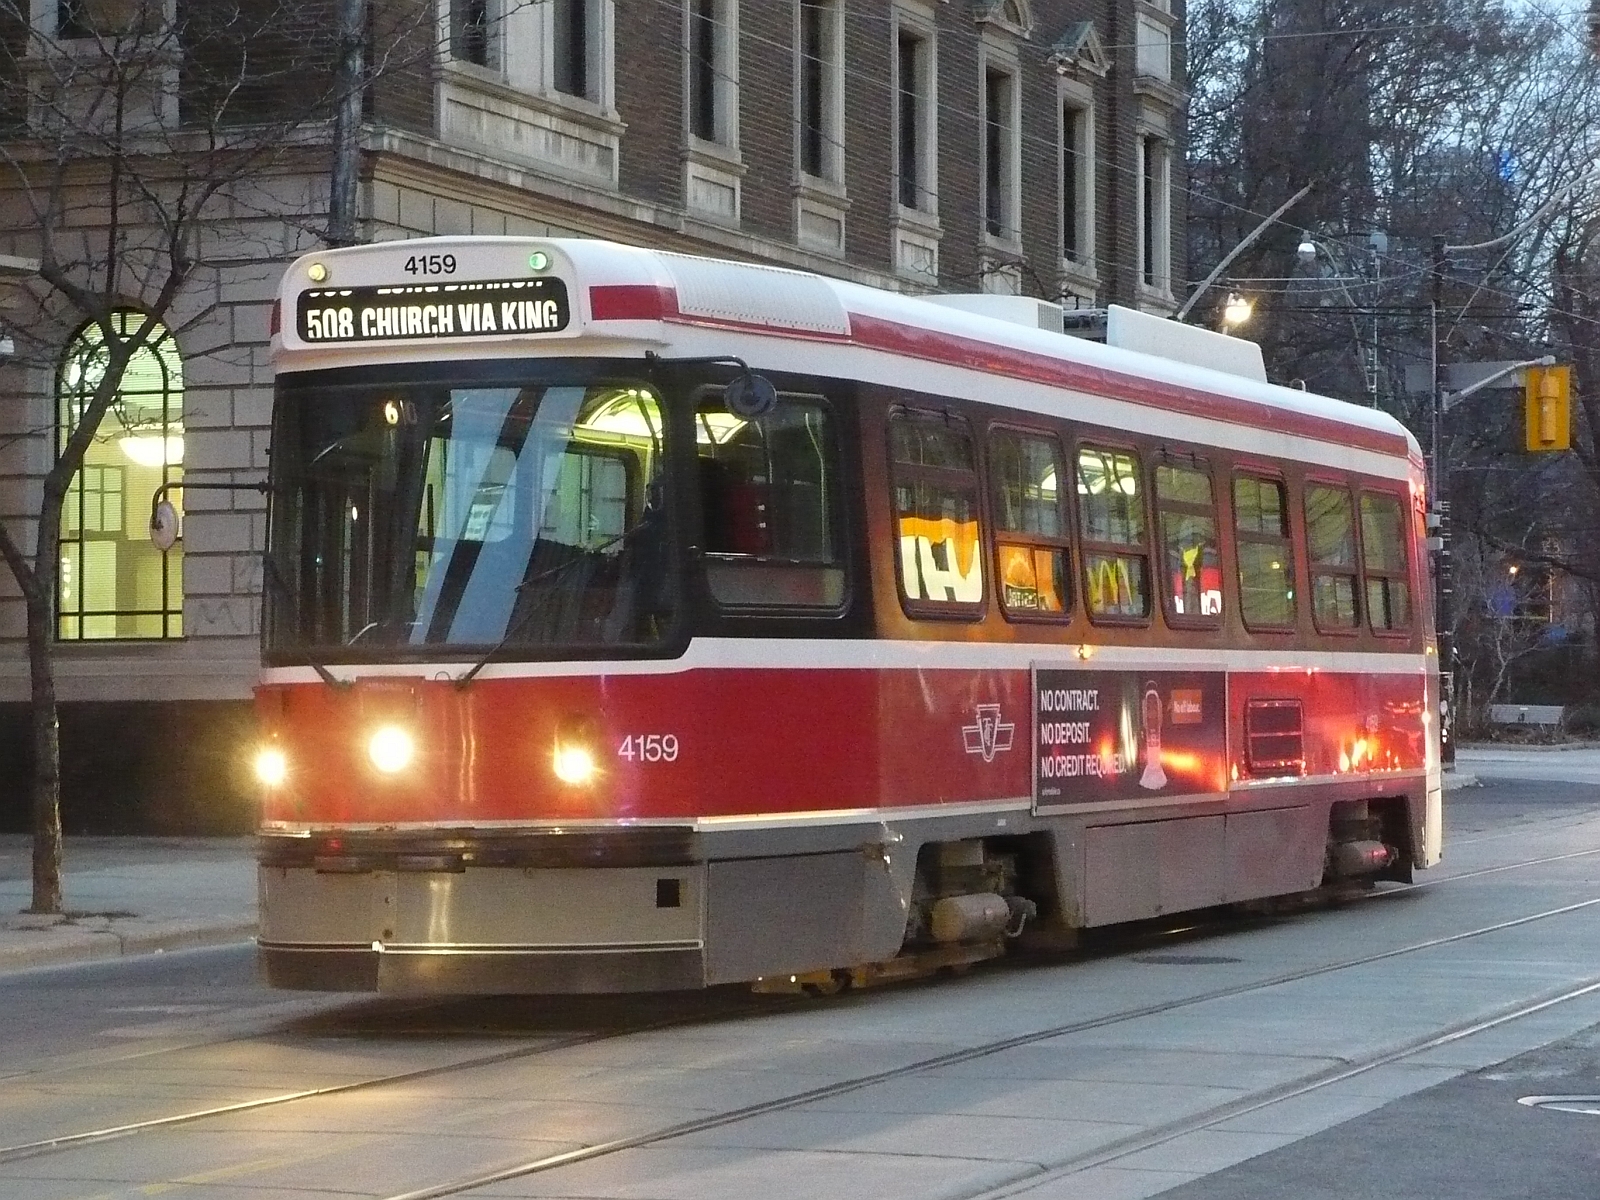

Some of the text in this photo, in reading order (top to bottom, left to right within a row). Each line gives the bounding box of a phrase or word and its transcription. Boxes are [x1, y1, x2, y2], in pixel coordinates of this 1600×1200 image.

[404, 254, 457, 275] 4159
[306, 299, 559, 339] 508 CHURCH VIA KING
[1041, 689, 1100, 711] NO CONTRACT.
[1041, 722, 1092, 745] NO DEPOSIT.
[617, 734, 679, 762] 4159
[1041, 753, 1127, 778] NO CREDIT REQUED.
